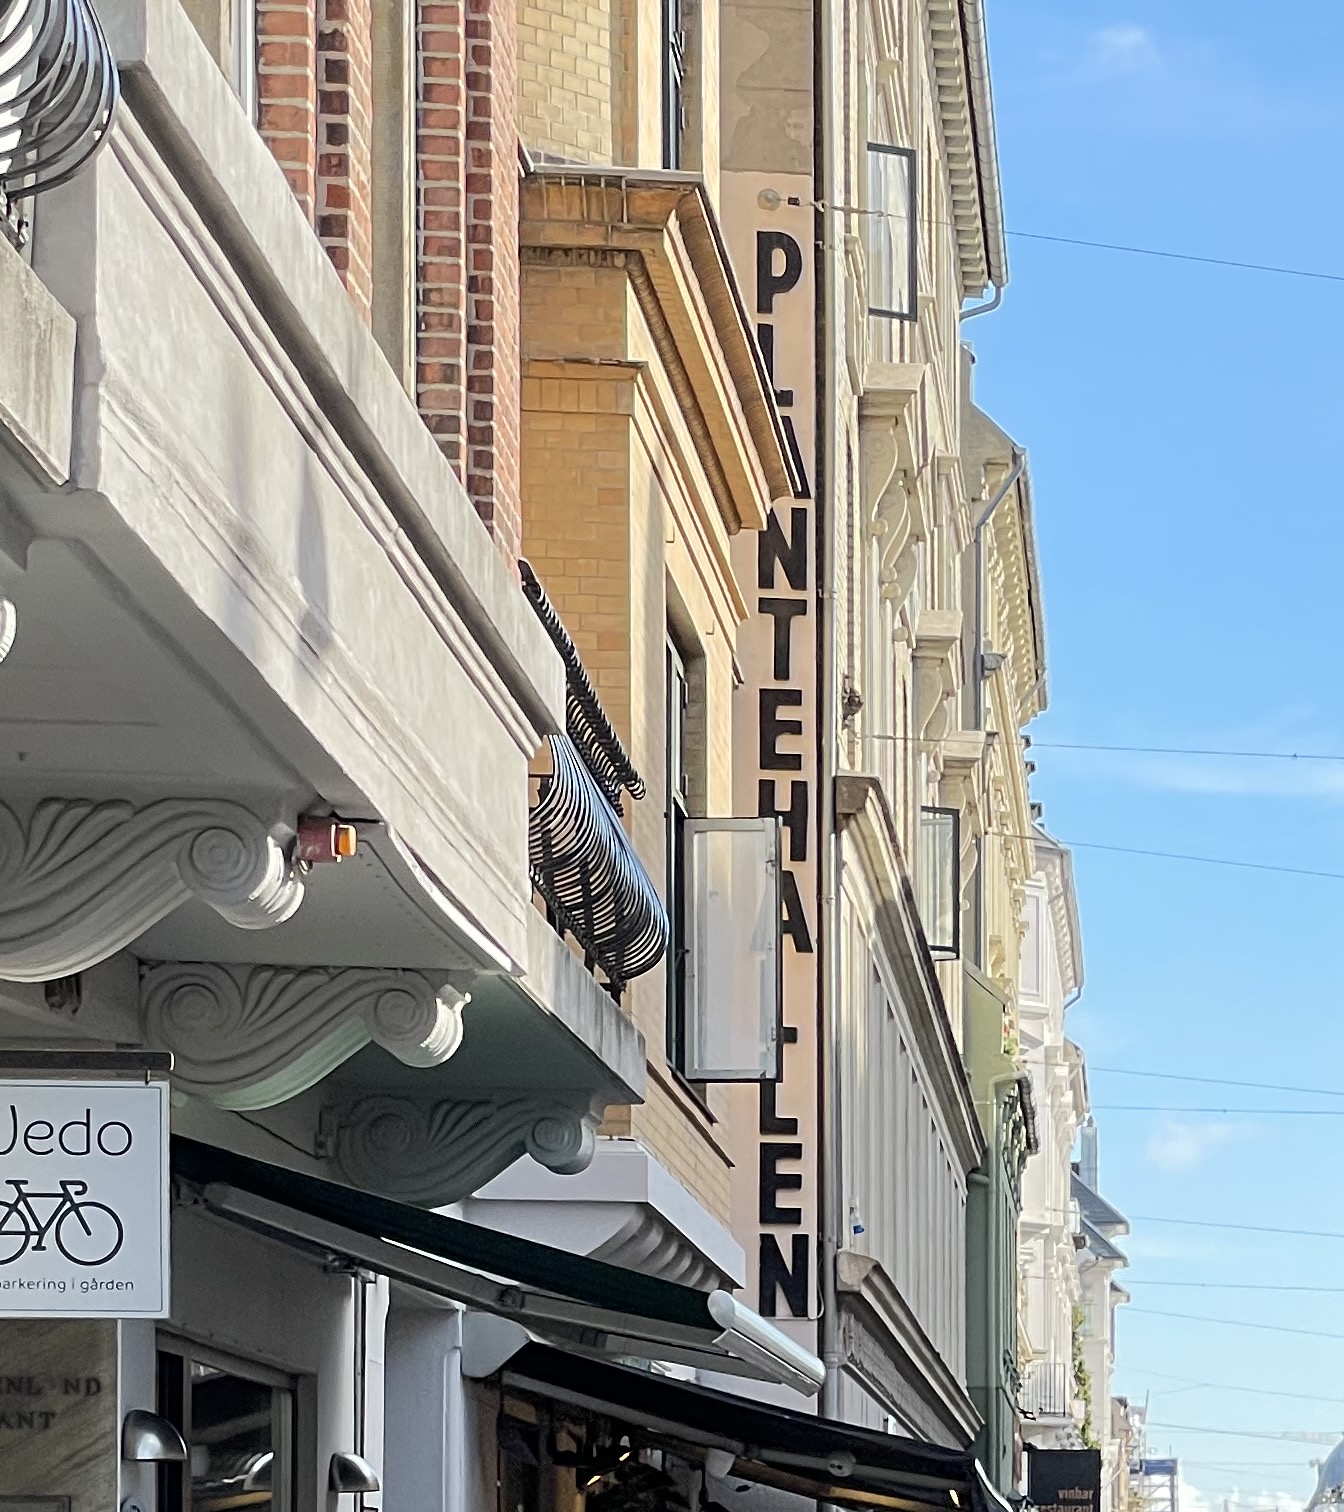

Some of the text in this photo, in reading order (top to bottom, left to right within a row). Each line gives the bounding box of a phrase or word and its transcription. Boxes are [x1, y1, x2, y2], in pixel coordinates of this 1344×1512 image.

[757, 230, 813, 1318] PLNTEHALEN
[0, 1278, 66, 1293] arkering
[80, 1278, 134, 1293] gården
